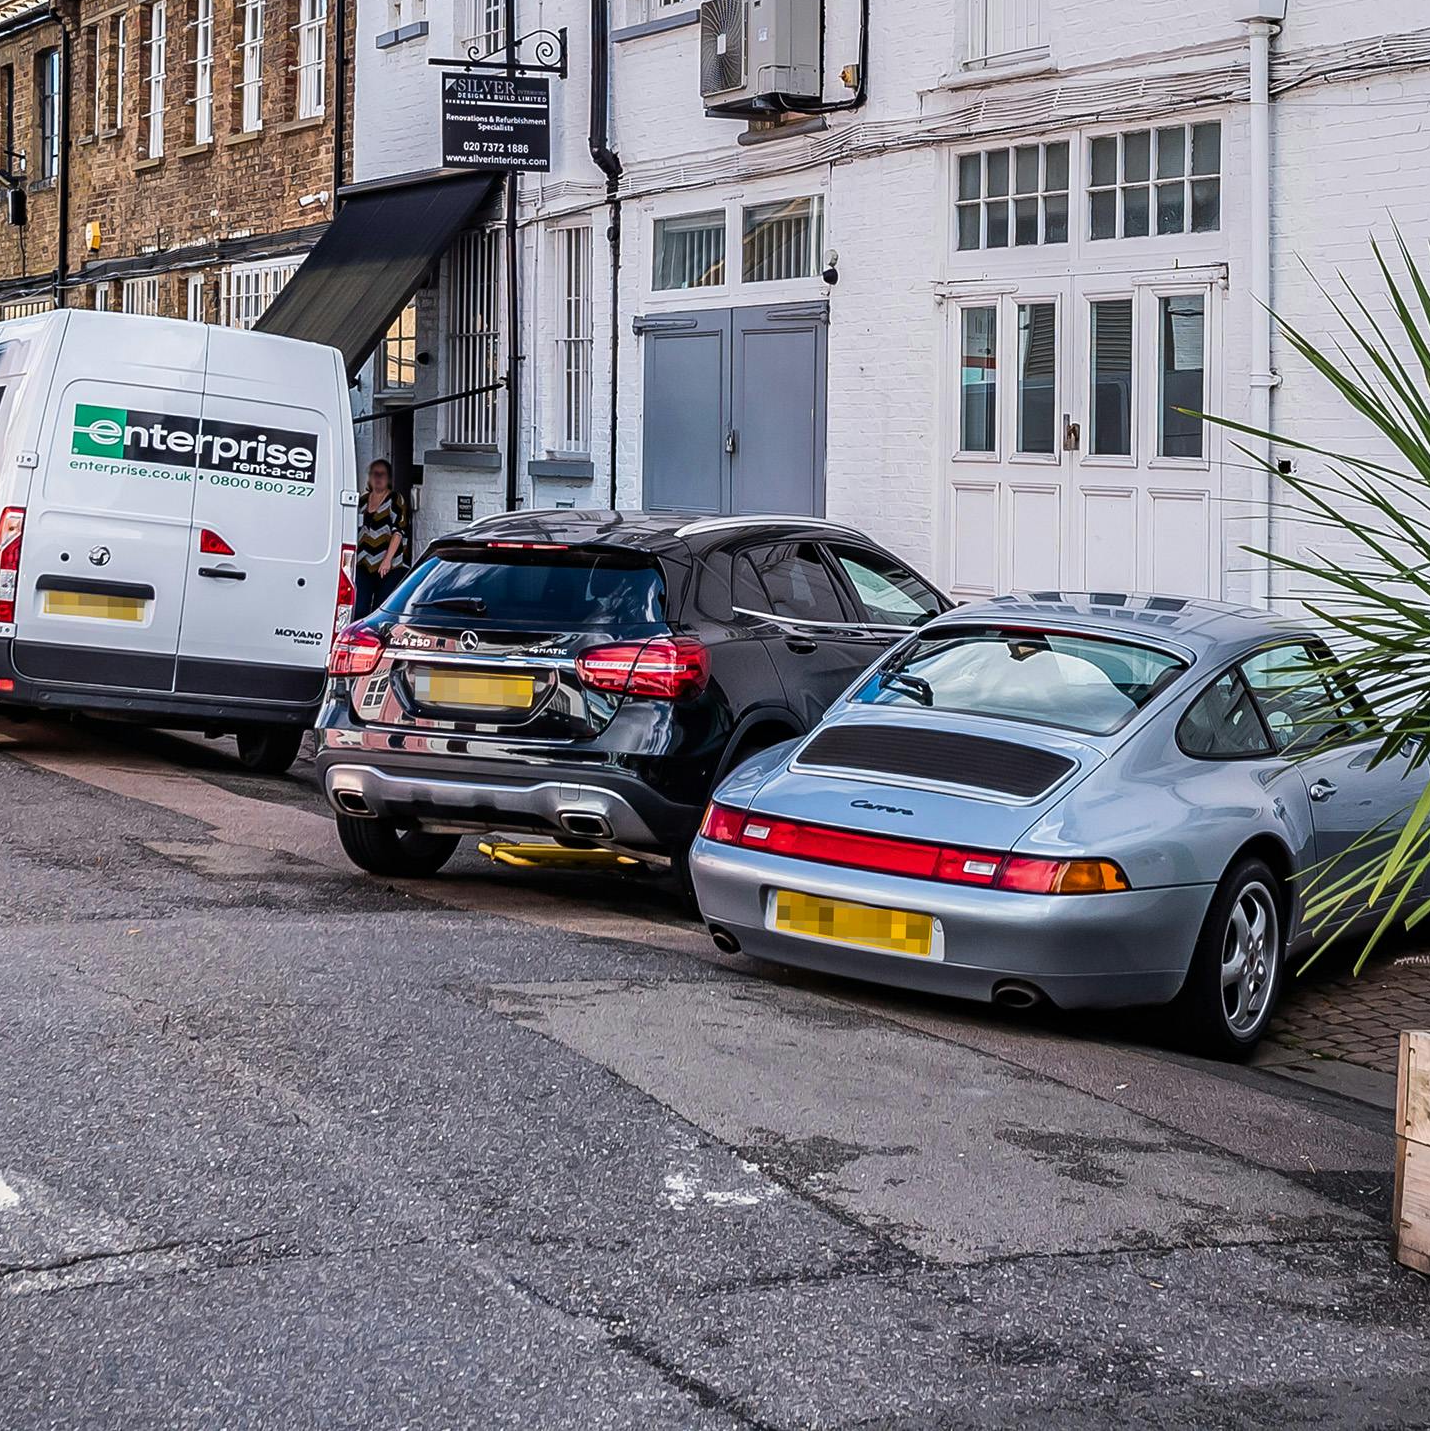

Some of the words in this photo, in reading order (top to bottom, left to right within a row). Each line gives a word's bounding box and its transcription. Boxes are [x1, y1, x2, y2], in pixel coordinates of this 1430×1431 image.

[457, 78, 515, 95] SILVER
[457, 92, 484, 100] DESIGN
[446, 113, 488, 123] Renovations
[495, 116, 546, 126] Refurbishment
[477, 122, 514, 132] Specialists
[463, 141, 480, 151] 020
[482, 142, 505, 153] 7372
[446, 154, 548, 166] www.silverinteriors.com
[73, 419, 314, 468] enterprise
[232, 460, 312, 480] rent-a-car
[69, 460, 192, 482] enterprise.co.uk
[210, 475, 250, 489] 0800
[254, 480, 283, 494] 800
[288, 484, 315, 498] 227
[274, 628, 323, 640] MOVANO
[850, 799, 914, 816] Carrera
